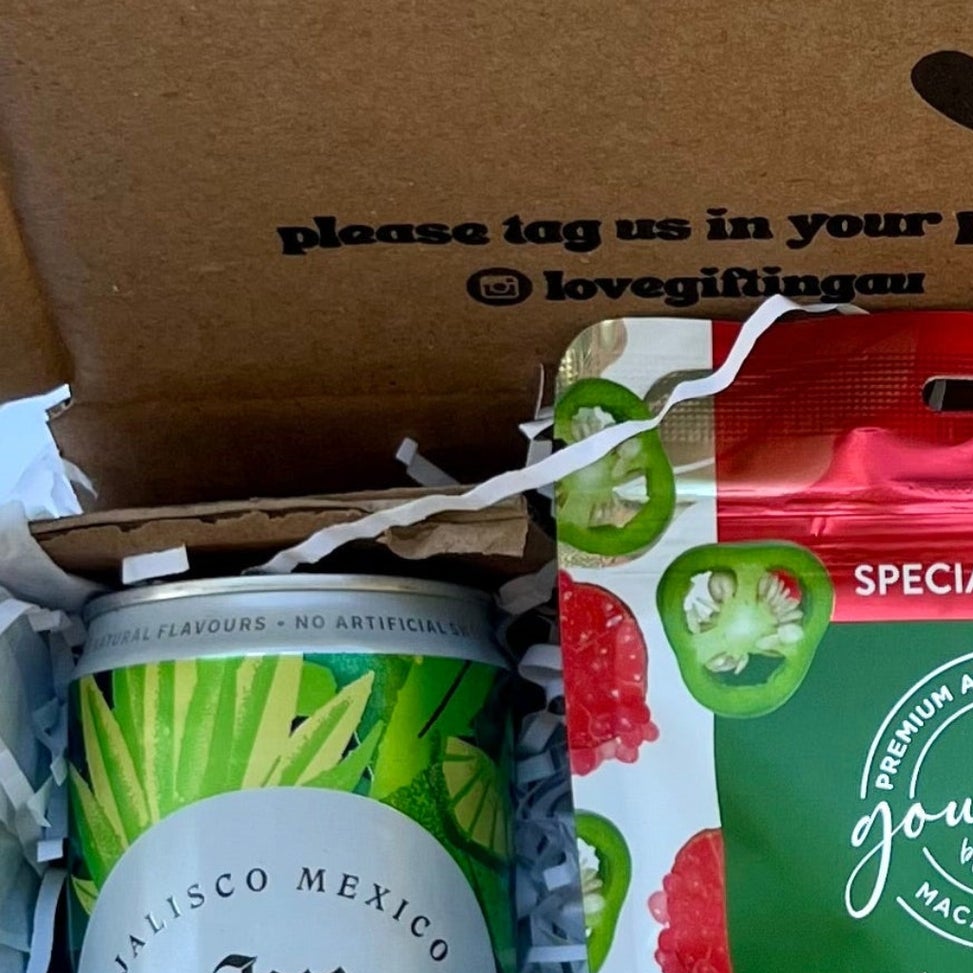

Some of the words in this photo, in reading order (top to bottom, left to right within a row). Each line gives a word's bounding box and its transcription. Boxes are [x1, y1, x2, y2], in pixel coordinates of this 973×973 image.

[277, 215, 490, 255] please
[501, 214, 602, 252] tag
[615, 216, 692, 241] us
[706, 208, 774, 241] in
[786, 209, 943, 249] your
[542, 266, 926, 304] lovegiftingau
[157, 616, 266, 639] FLAVOURS
[295, 615, 325, 629] NO
[336, 615, 448, 635] ARTIFICIAL
[875, 685, 954, 789] PREMIUM
[296, 866, 449, 962] MEXICO
